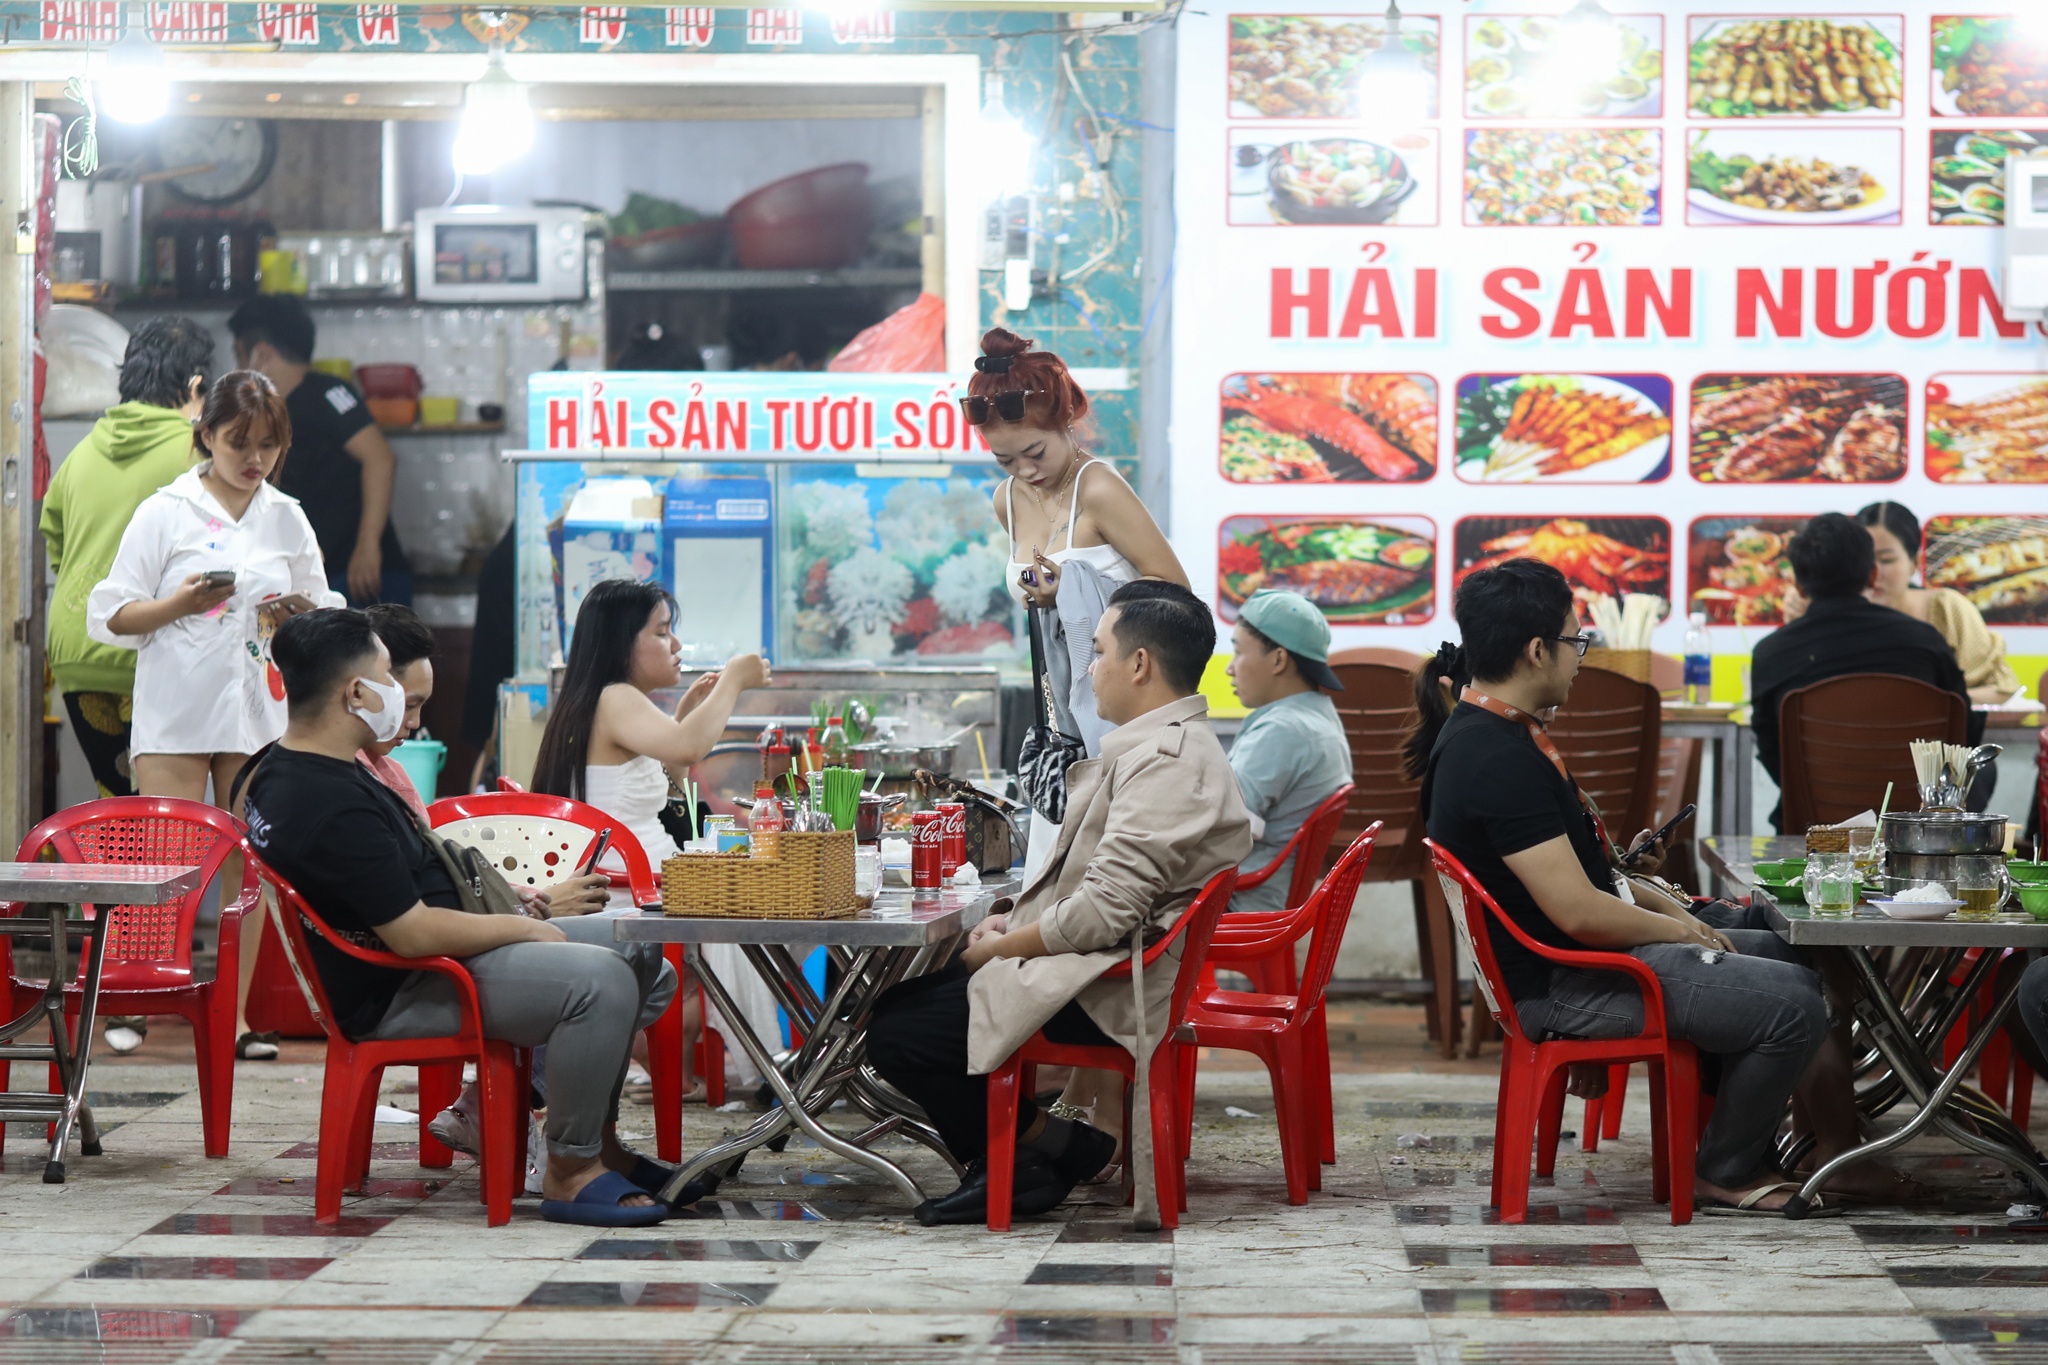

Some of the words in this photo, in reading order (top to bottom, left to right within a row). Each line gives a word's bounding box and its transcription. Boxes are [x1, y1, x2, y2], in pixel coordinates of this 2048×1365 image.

[1270, 241, 1437, 338] HẢI
[1481, 241, 1692, 339] SẢN
[1735, 251, 2048, 339] NƯỚN
[549, 382, 627, 449] HẢI
[648, 382, 747, 450] SẢN
[766, 396, 872, 451] TƯƠI
